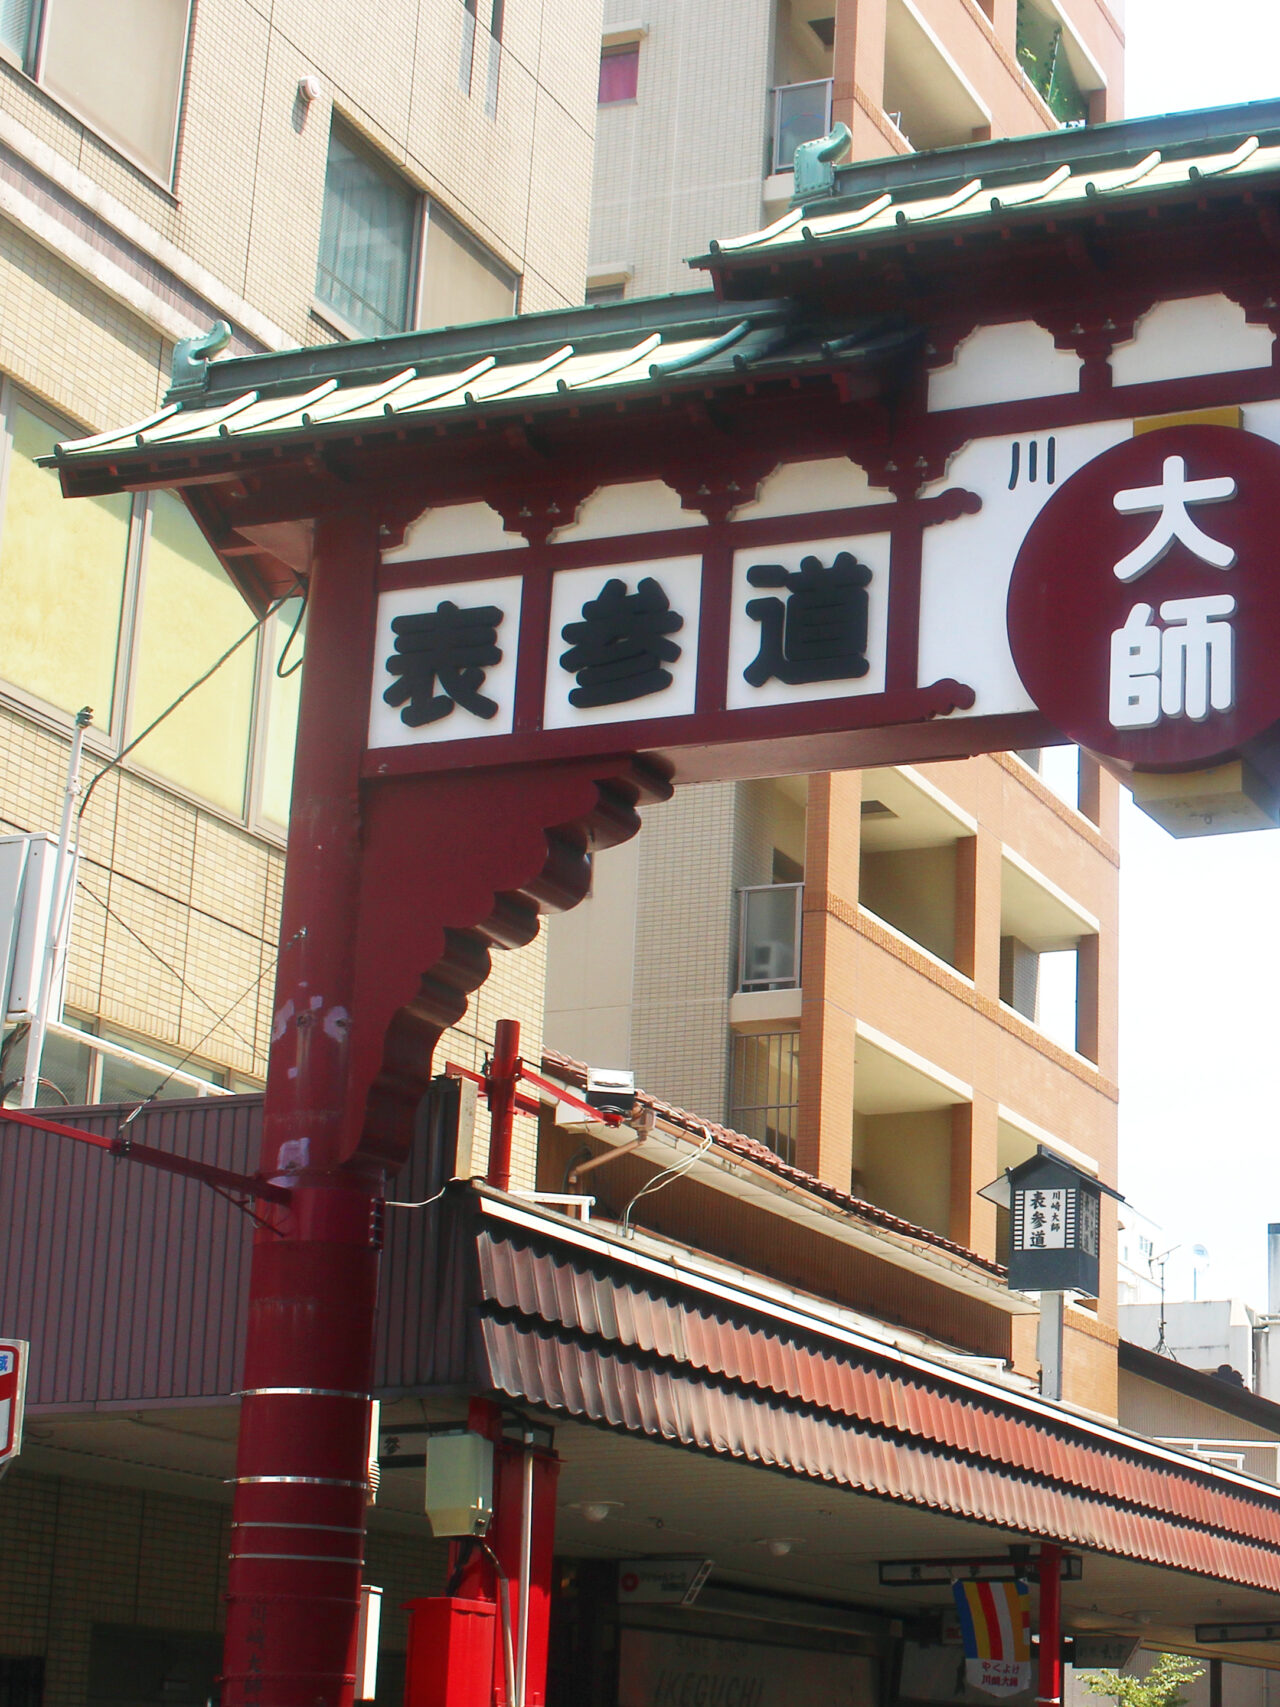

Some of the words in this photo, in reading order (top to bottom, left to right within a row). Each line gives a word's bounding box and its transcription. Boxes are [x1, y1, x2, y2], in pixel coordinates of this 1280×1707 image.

[383, 551, 873, 728] 表参道
[1108, 455, 1238, 730] 大師
[1030, 1191, 1047, 1249] 表参道
[1050, 1191, 1061, 1233] 川崎大師
